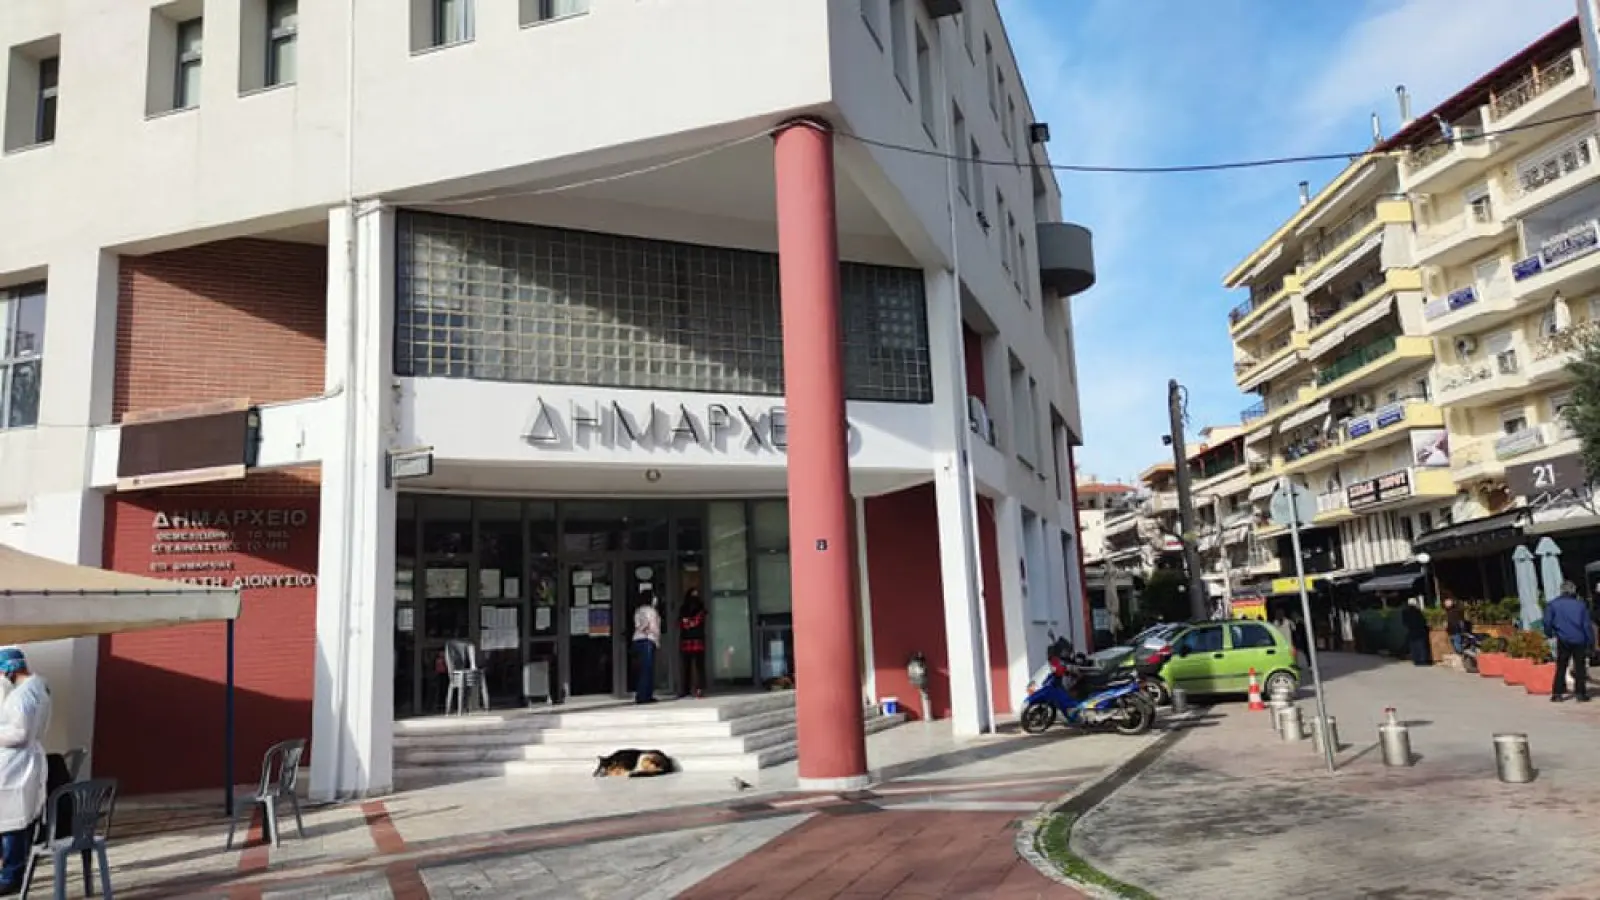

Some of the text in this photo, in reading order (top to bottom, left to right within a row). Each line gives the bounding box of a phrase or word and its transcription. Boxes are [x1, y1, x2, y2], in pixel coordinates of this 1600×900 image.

[520, 395, 859, 455] ΔΗΜΑΡΧΕ
[1532, 464, 1556, 488] 21
[152, 508, 308, 529] ΔΗΜΑΡΧΕΙΟ
